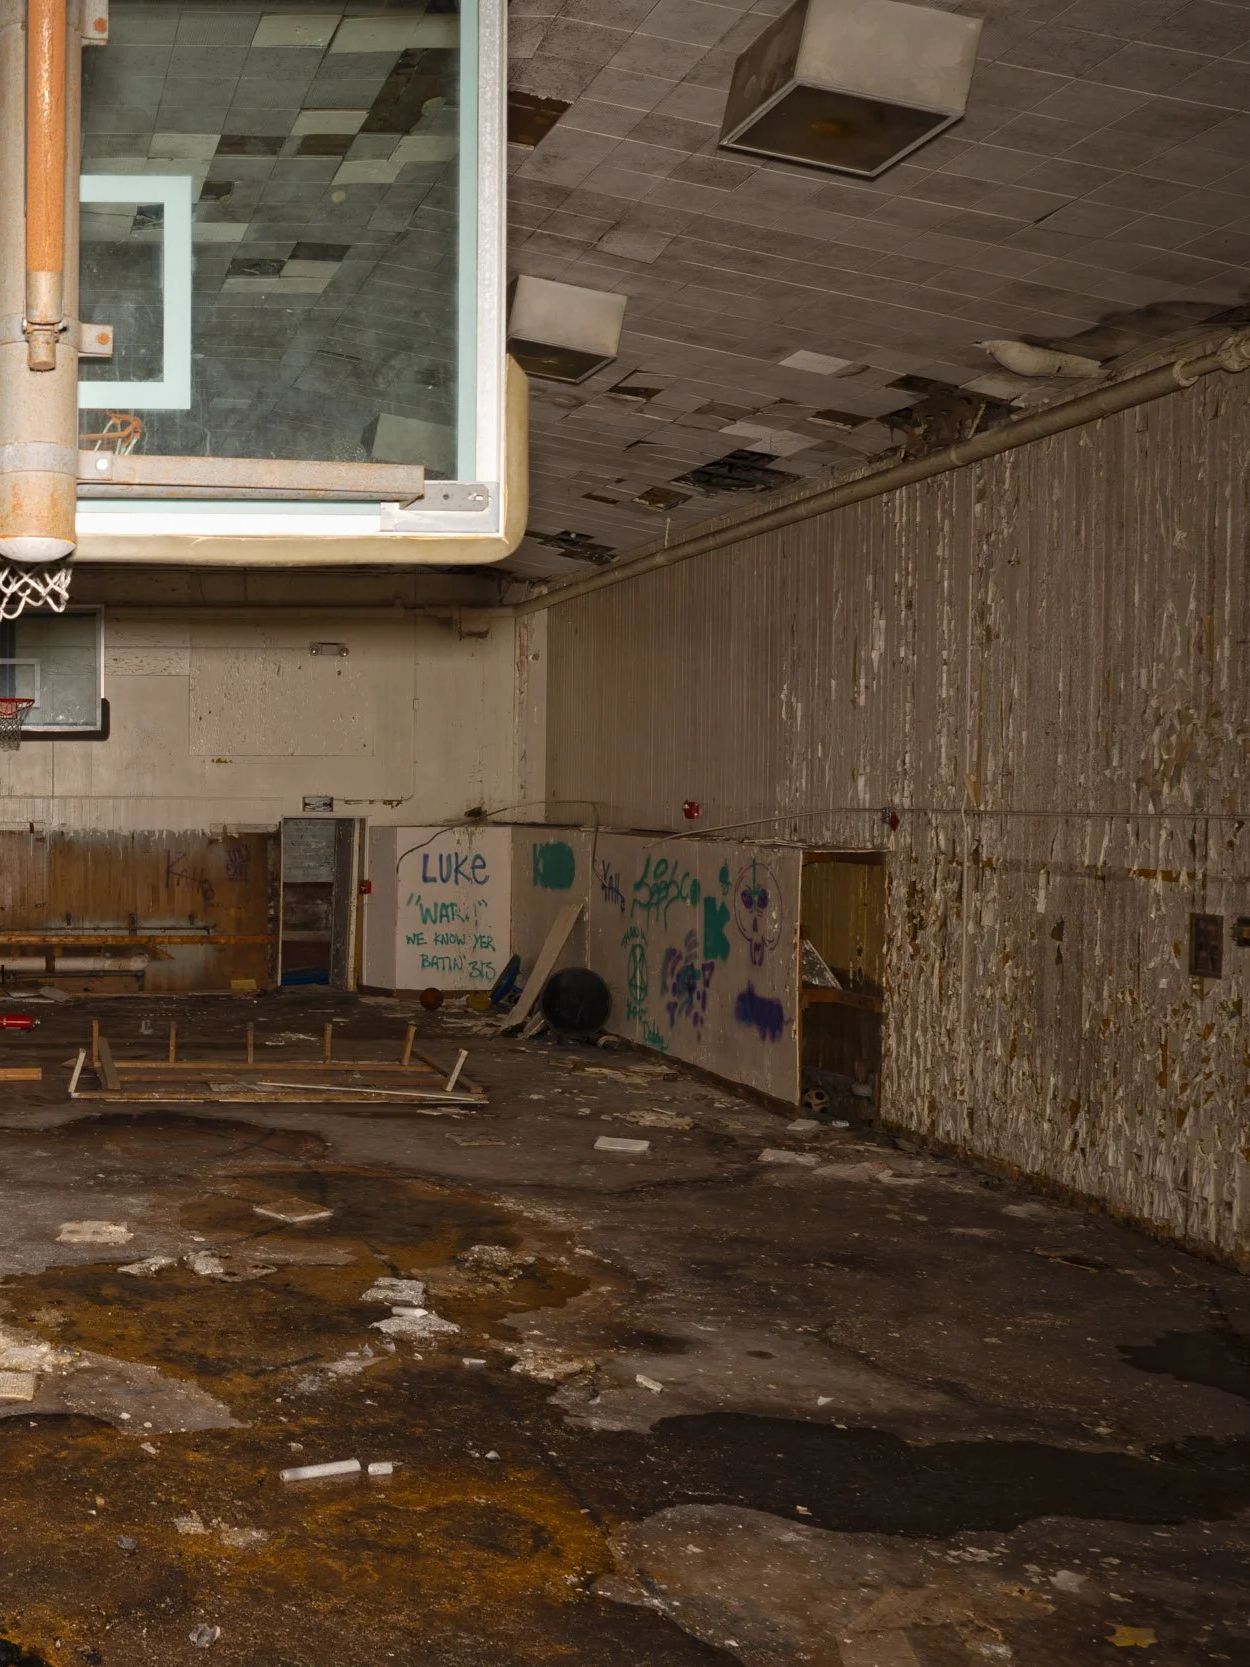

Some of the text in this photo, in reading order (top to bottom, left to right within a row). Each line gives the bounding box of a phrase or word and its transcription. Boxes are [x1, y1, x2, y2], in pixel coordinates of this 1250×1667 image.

[406, 932, 496, 952] WE KNOW YER
